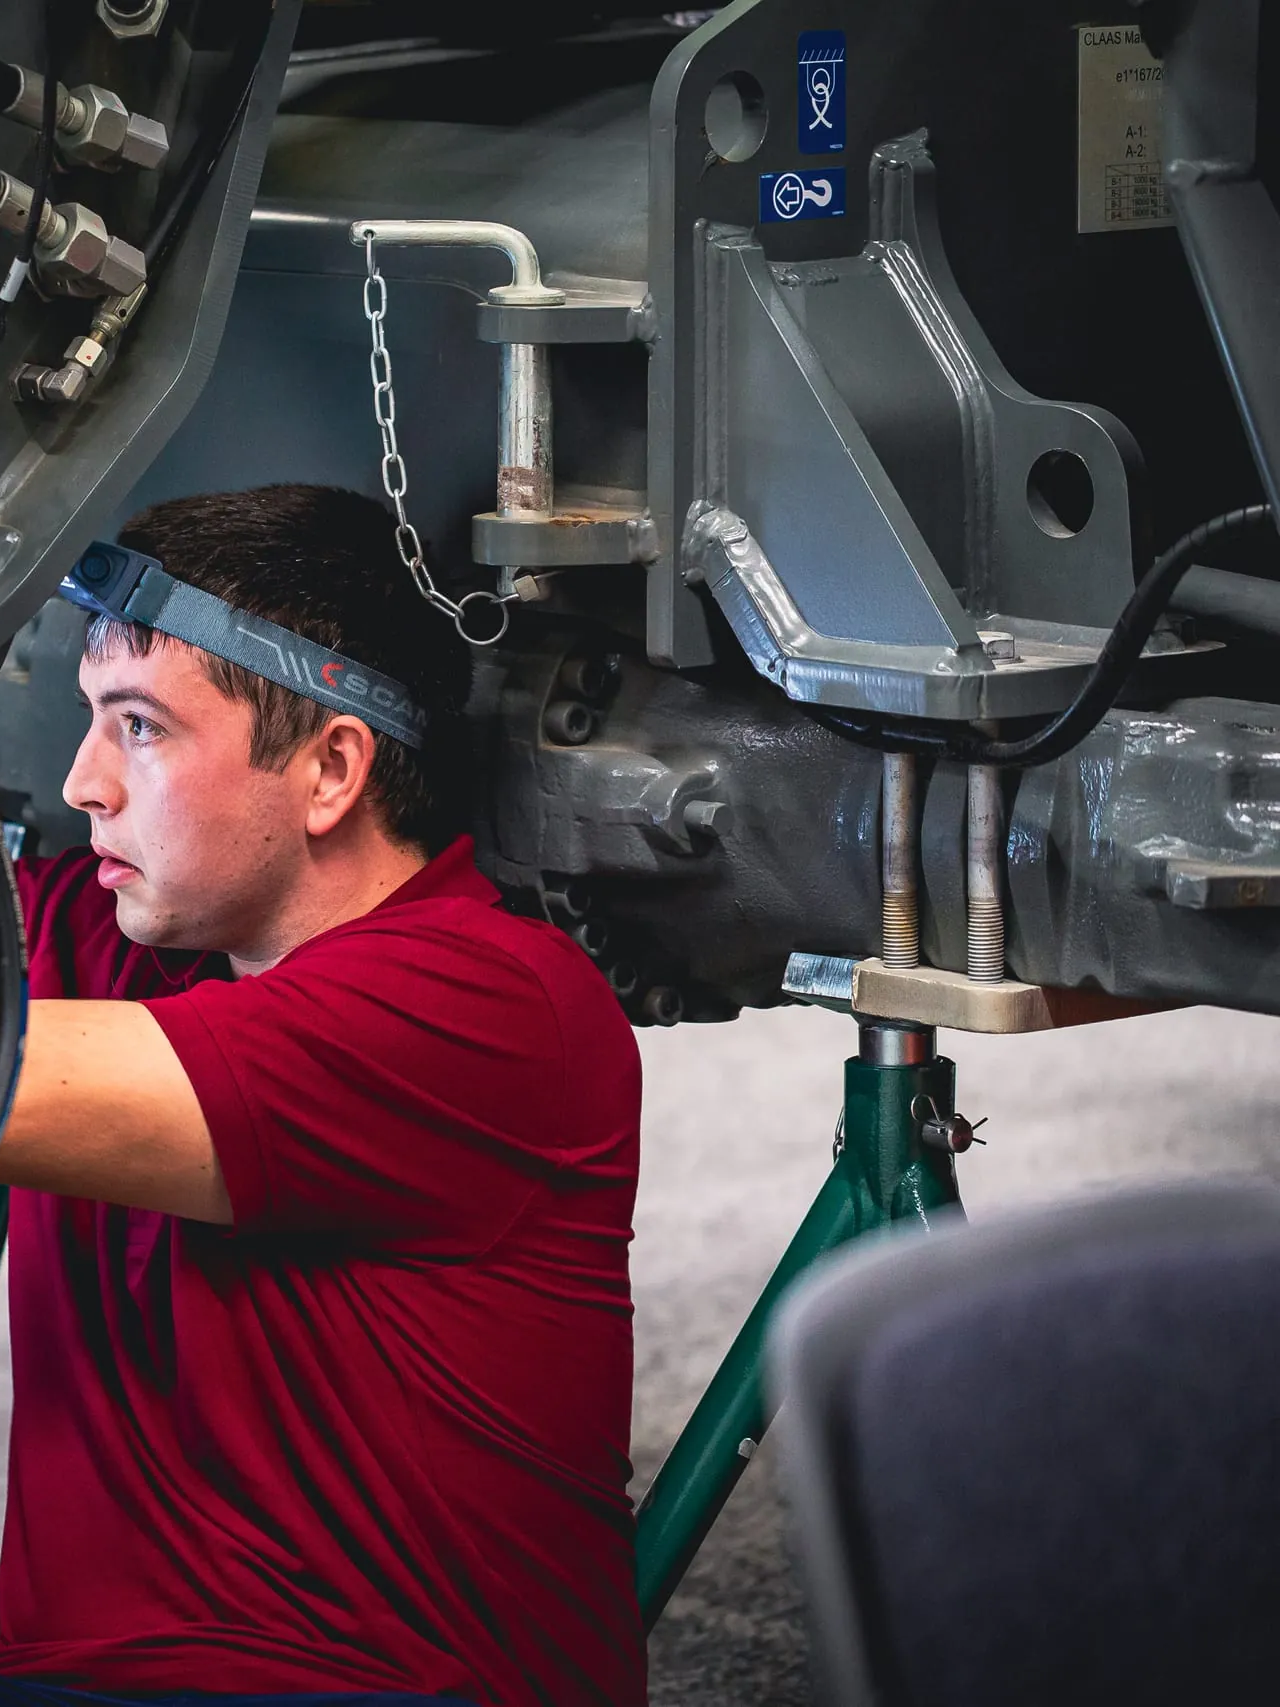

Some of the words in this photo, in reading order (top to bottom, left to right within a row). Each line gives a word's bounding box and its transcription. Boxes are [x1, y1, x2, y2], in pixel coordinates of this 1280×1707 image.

[1084, 31, 1121, 46] CLAAS
[1125, 125, 1147, 139] A-1:
[1125, 143, 1147, 158] A-2:
